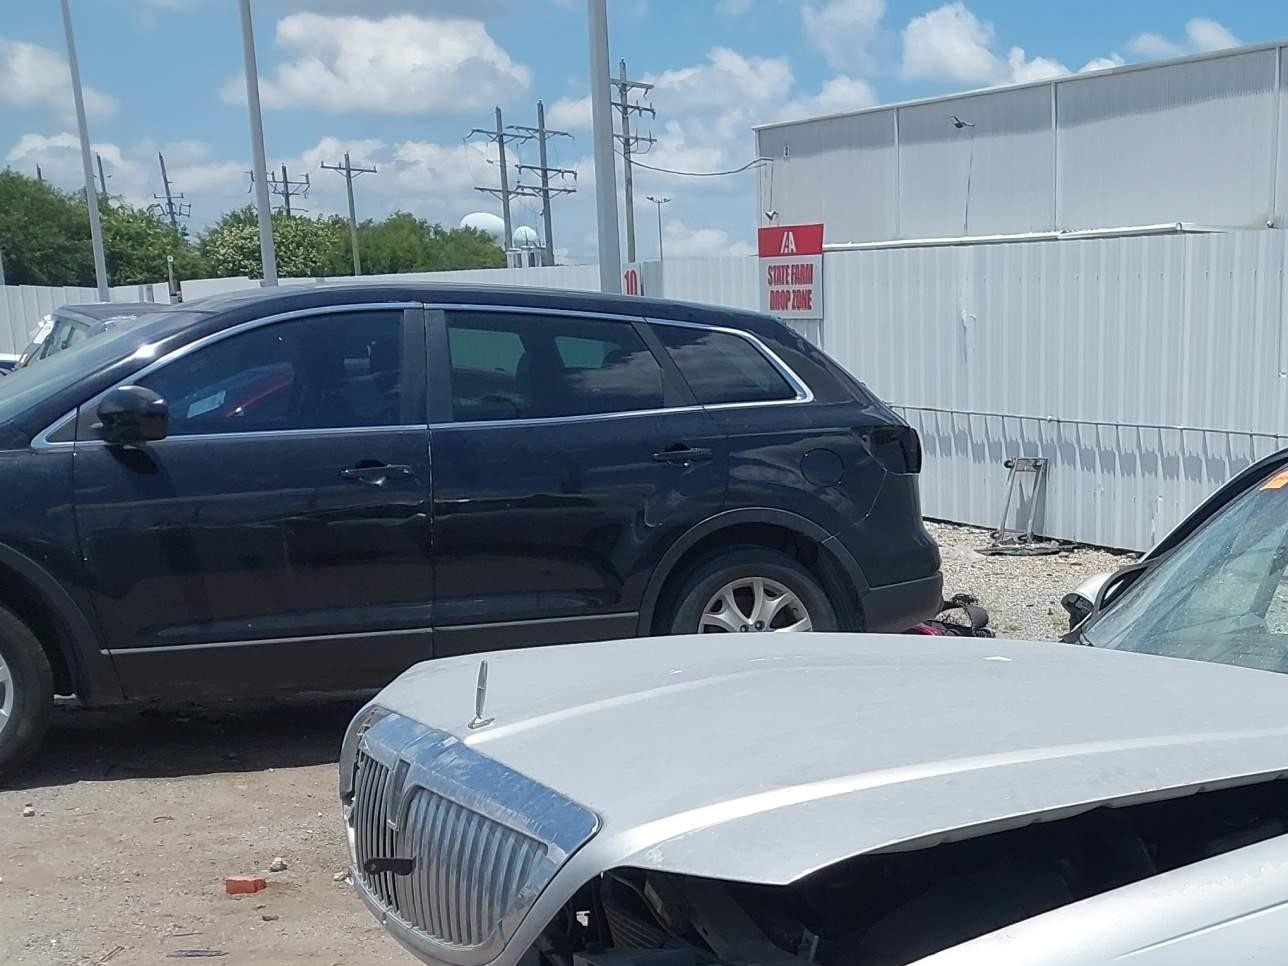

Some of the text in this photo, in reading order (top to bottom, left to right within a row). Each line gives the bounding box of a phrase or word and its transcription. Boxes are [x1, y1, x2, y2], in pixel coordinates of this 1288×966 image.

[624, 269, 638, 296] 10
[767, 263, 814, 286] STATE FARM
[769, 289, 812, 311] DROP ZONE
